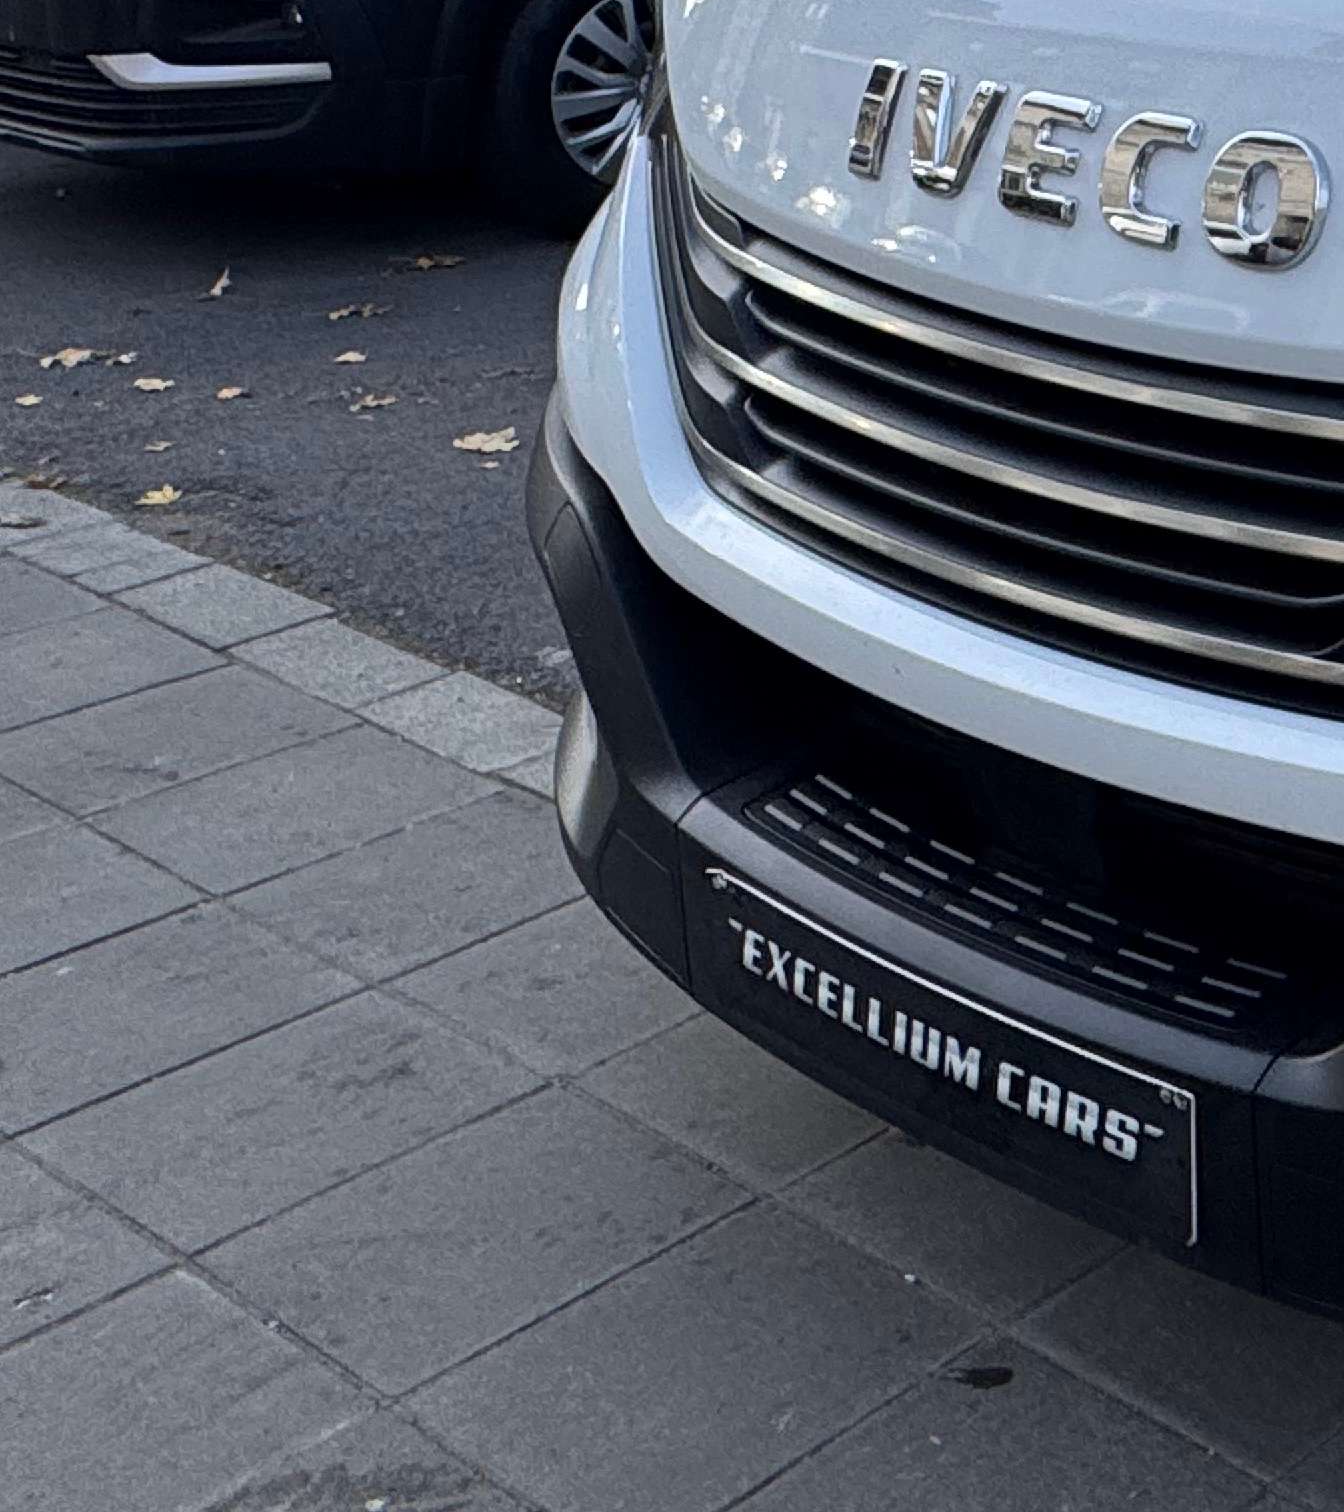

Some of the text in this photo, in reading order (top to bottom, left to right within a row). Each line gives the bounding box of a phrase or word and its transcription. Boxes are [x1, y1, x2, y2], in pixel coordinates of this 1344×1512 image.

[847, 57, 1332, 272] IVECO
[742, 927, 1140, 1163] EXCELLIUM CARS
